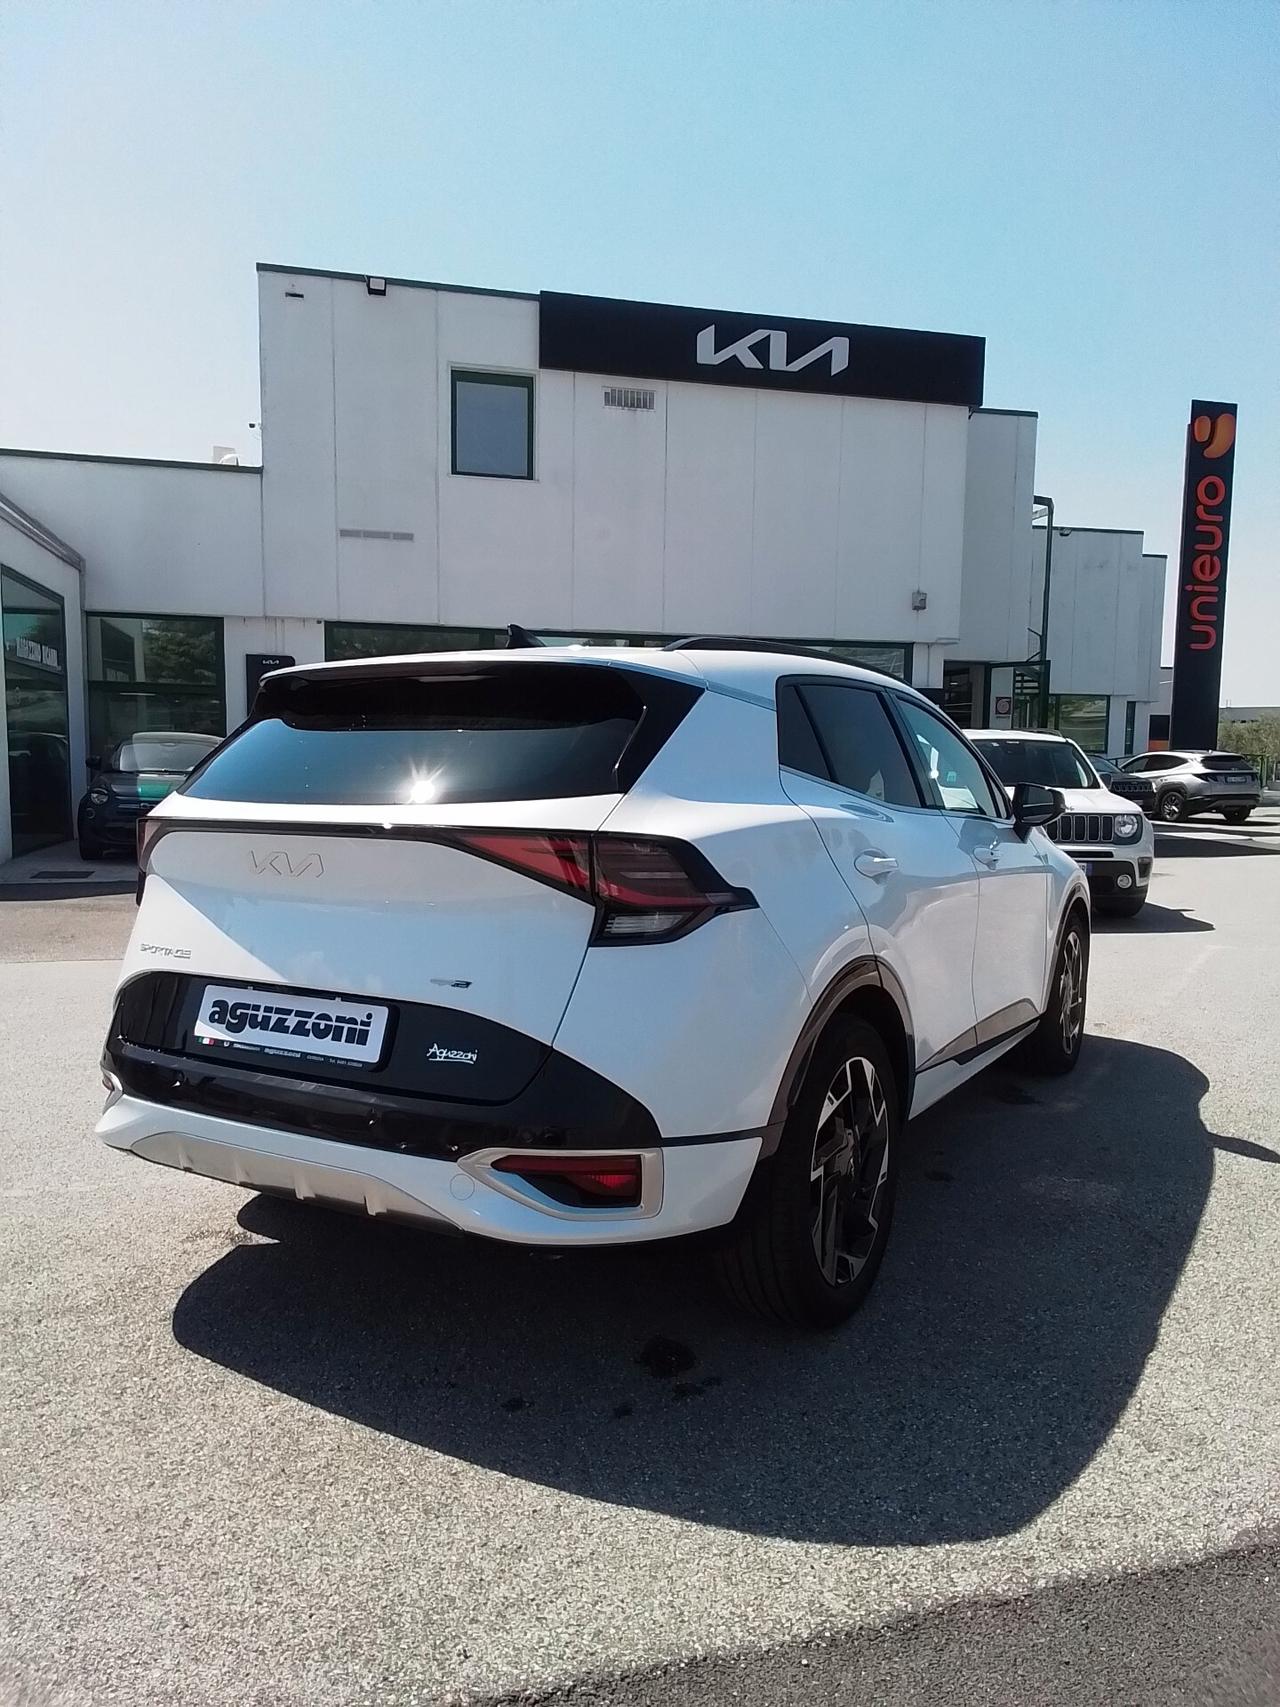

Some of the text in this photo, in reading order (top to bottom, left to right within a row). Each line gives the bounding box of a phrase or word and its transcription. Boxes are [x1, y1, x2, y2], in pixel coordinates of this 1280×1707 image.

[697, 324, 850, 377] KIA
[1184, 474, 1227, 651] unieuro
[249, 849, 325, 878] KIA
[208, 999, 373, 1047] aguzzoni
[426, 1042, 479, 1064] Aguzzoni
